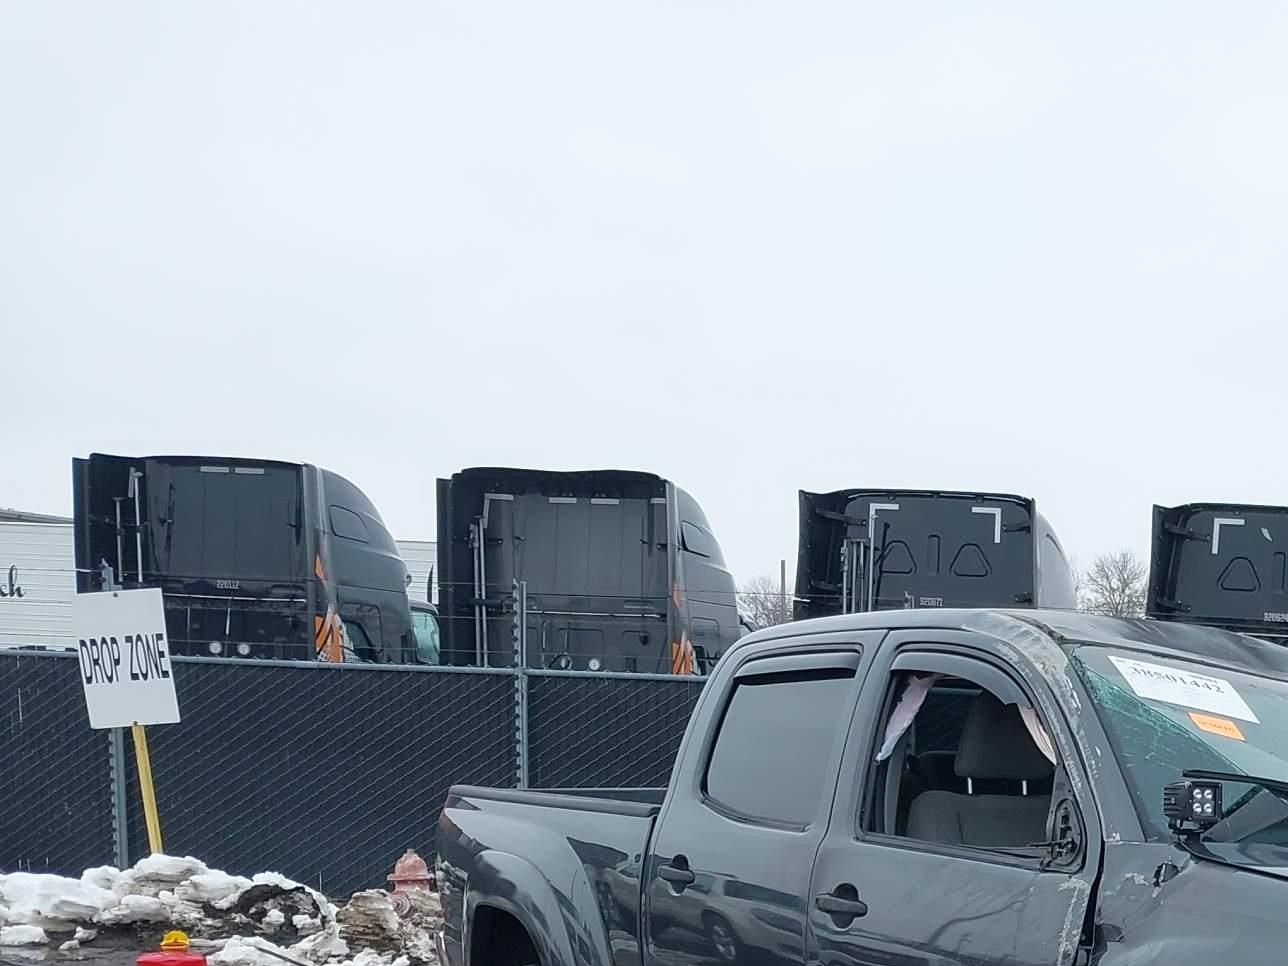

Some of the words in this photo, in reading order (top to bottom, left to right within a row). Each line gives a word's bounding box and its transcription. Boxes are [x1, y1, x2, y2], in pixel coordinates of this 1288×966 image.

[79, 636, 121, 685] DROP
[124, 633, 170, 681] ZONE
[1128, 666, 1225, 694] 38501442
